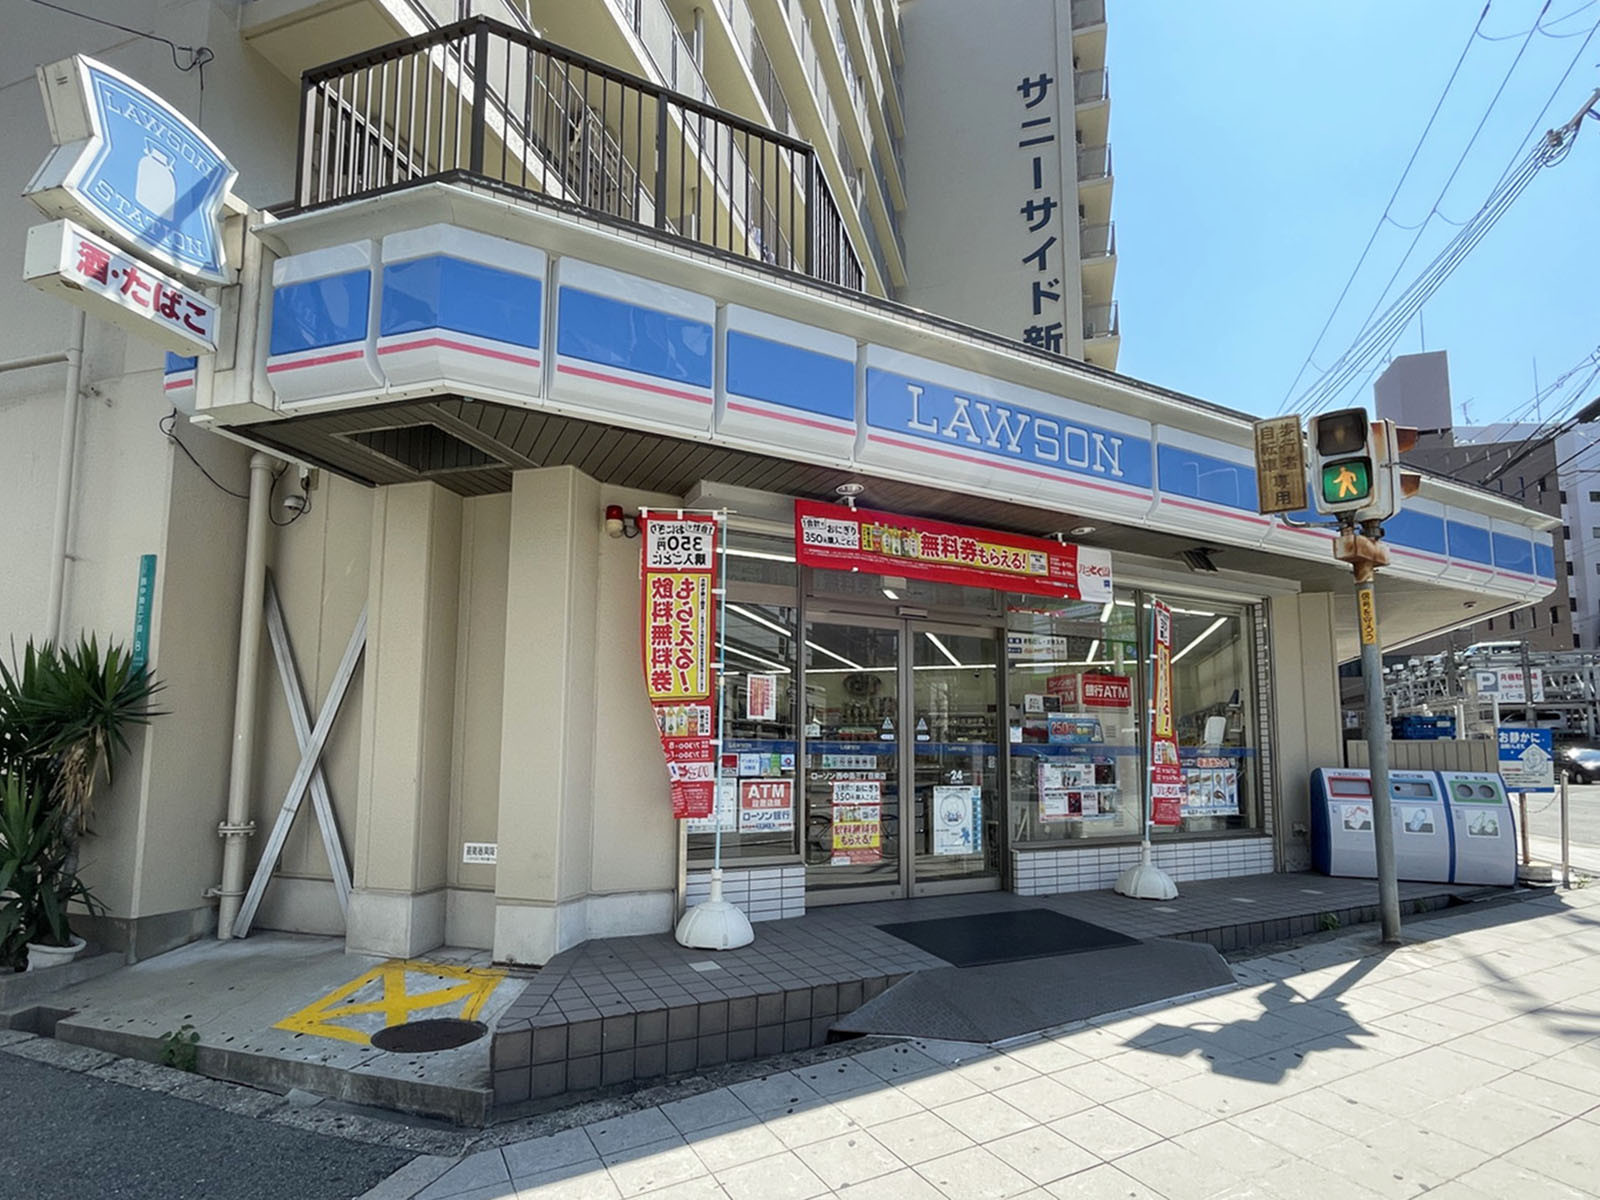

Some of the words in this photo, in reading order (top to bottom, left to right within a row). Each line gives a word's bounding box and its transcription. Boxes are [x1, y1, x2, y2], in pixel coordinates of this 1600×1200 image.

[104, 90, 216, 180] LAWSON
[95, 180, 206, 258] STATION
[75, 240, 207, 336] 酒・たばこ
[906, 383, 1125, 477] LAWSON
[1278, 422, 1299, 470] 歩行者
[827, 524, 857, 536] おにぎり
[1085, 683, 1129, 699] 銀行ATM
[1500, 691, 1541, 700] パーキグ
[950, 769, 963, 780] 24
[747, 784, 785, 799] ATM
[743, 810, 790, 821] ローソン銀行
